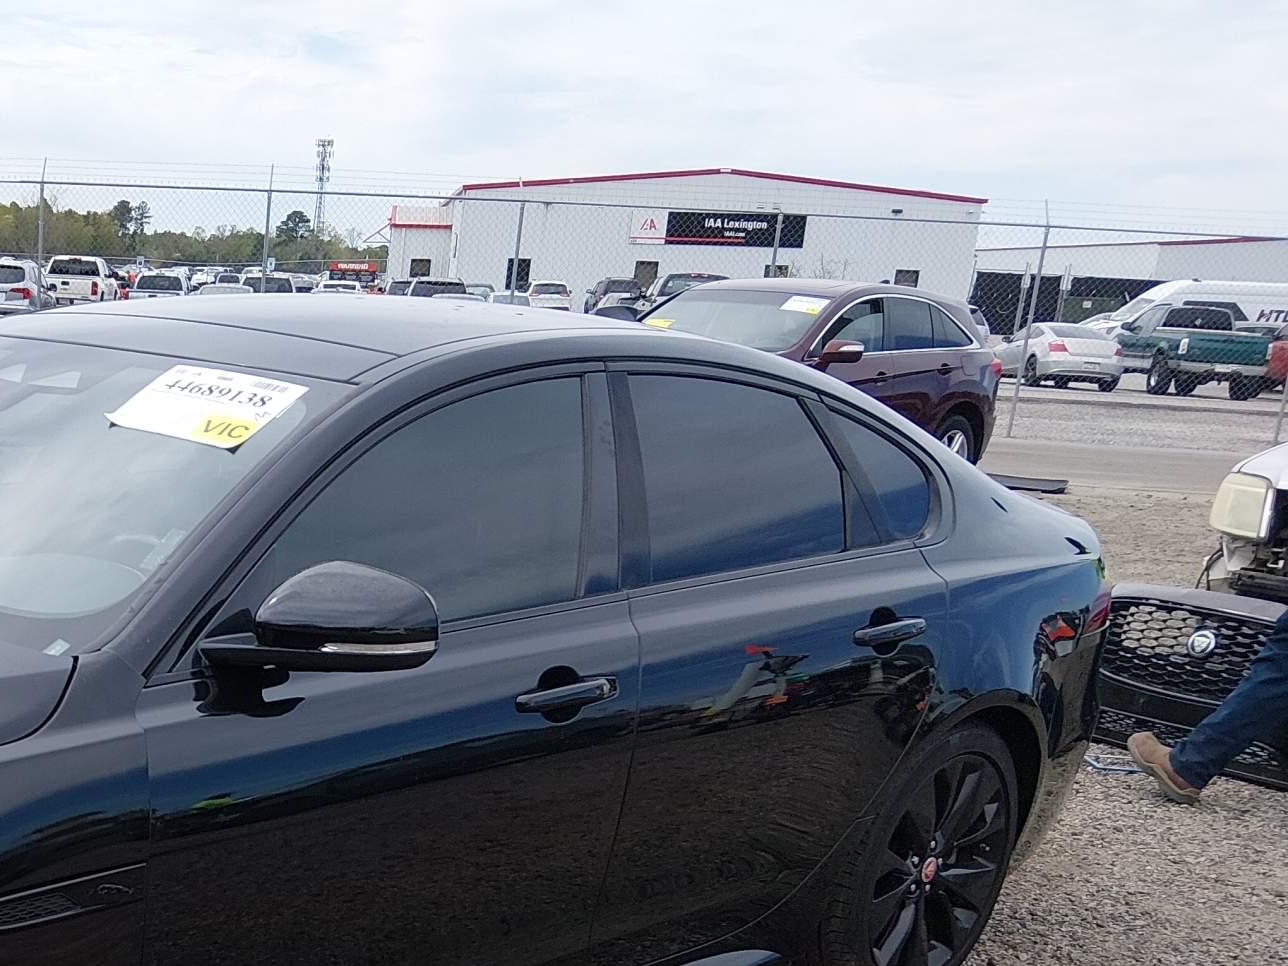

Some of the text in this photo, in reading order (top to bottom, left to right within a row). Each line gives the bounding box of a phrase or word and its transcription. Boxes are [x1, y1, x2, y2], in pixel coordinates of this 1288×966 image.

[704, 218, 768, 231] IAA Lexington
[165, 379, 273, 408] 44689138
[203, 419, 250, 439] VIC
